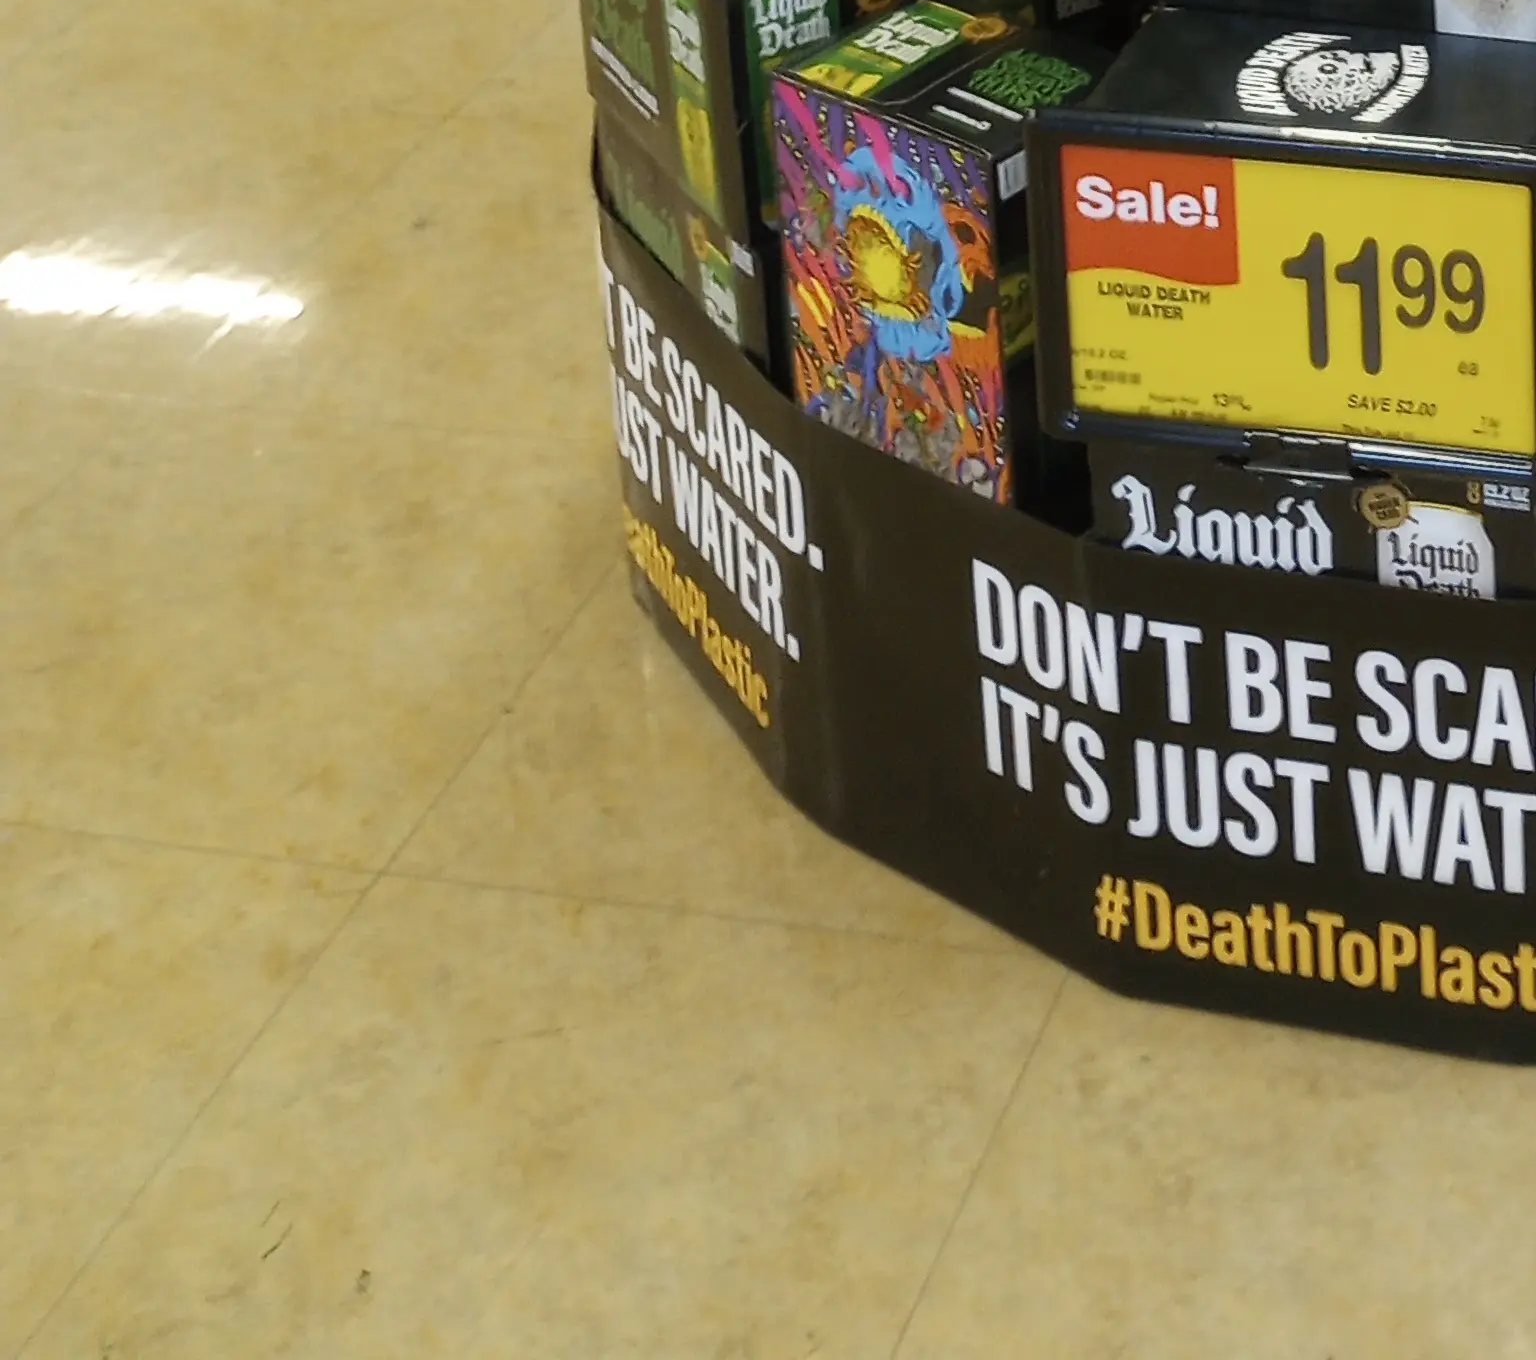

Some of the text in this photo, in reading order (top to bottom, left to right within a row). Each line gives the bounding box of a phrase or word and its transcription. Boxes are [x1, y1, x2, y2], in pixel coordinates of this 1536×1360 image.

[758, 14, 831, 58] Death
[1244, 31, 1352, 70] DEATH
[1236, 66, 1300, 118] LIQUID
[1074, 172, 1221, 230] Sale!
[1096, 280, 1212, 306] LIQUID DEATH
[1125, 301, 1185, 321] WATER
[1457, 360, 1481, 377] ea
[616, 283, 825, 572] BE SCARED.
[1347, 393, 1439, 418] SAVE $2.00
[610, 363, 801, 664] UST WATER.
[1110, 472, 1335, 578] Liquid
[1387, 530, 1480, 580] Liquid
[972, 557, 1204, 727] DON'T
[1224, 629, 1339, 745] BE
[977, 675, 1112, 828] IT'S
[1125, 736, 1332, 866] JUST
